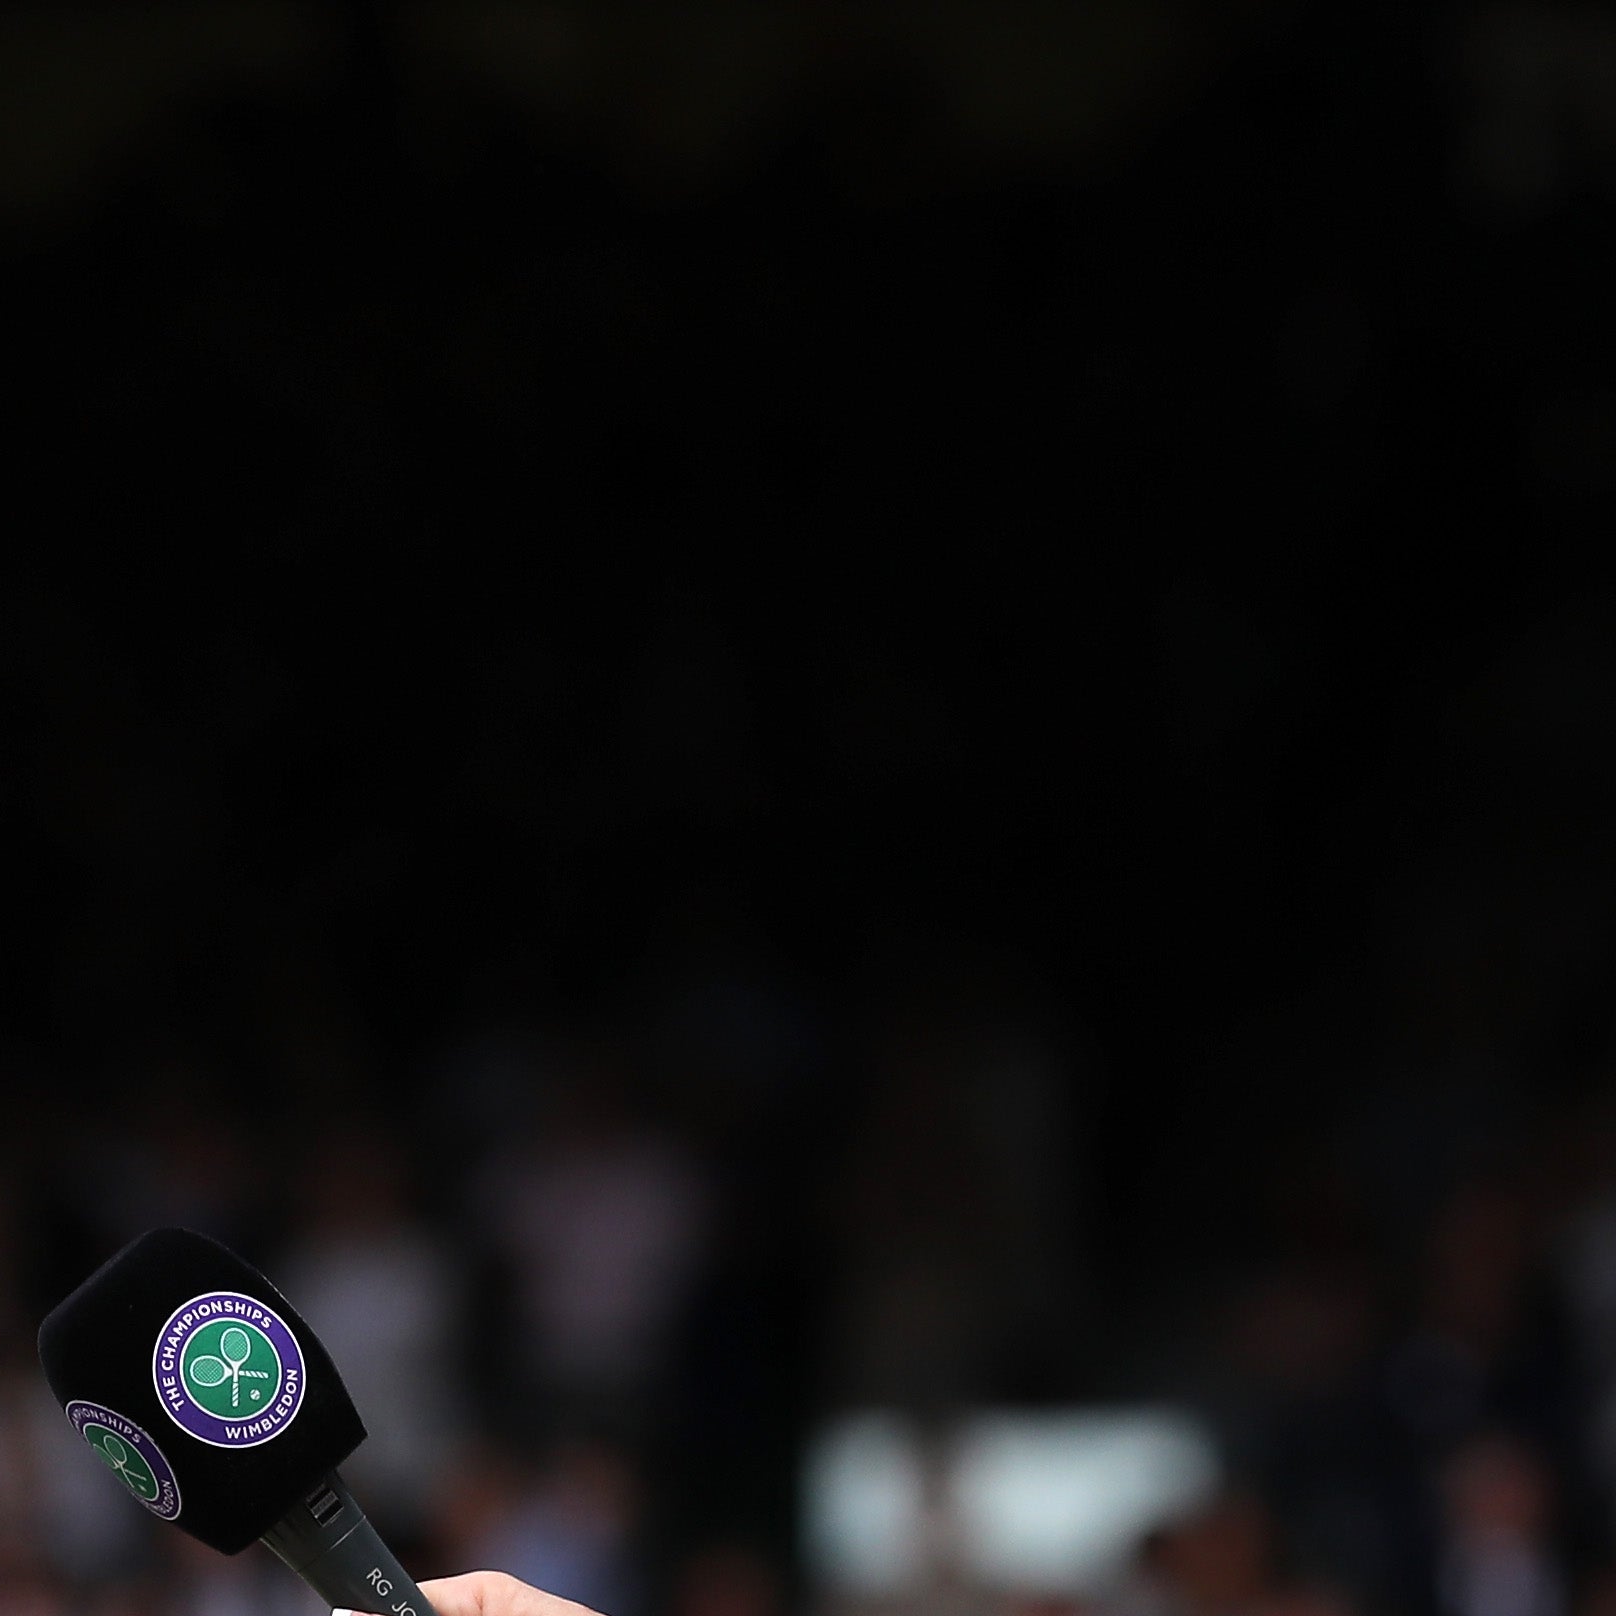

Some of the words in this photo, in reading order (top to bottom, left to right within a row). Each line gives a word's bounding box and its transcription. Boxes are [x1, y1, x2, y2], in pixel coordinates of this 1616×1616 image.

[161, 1300, 273, 1371] CHAMPIONSHIPS
[162, 1375, 185, 1412] THE
[225, 1368, 299, 1440] WIMBLEDON
[366, 1567, 394, 1597] RG
